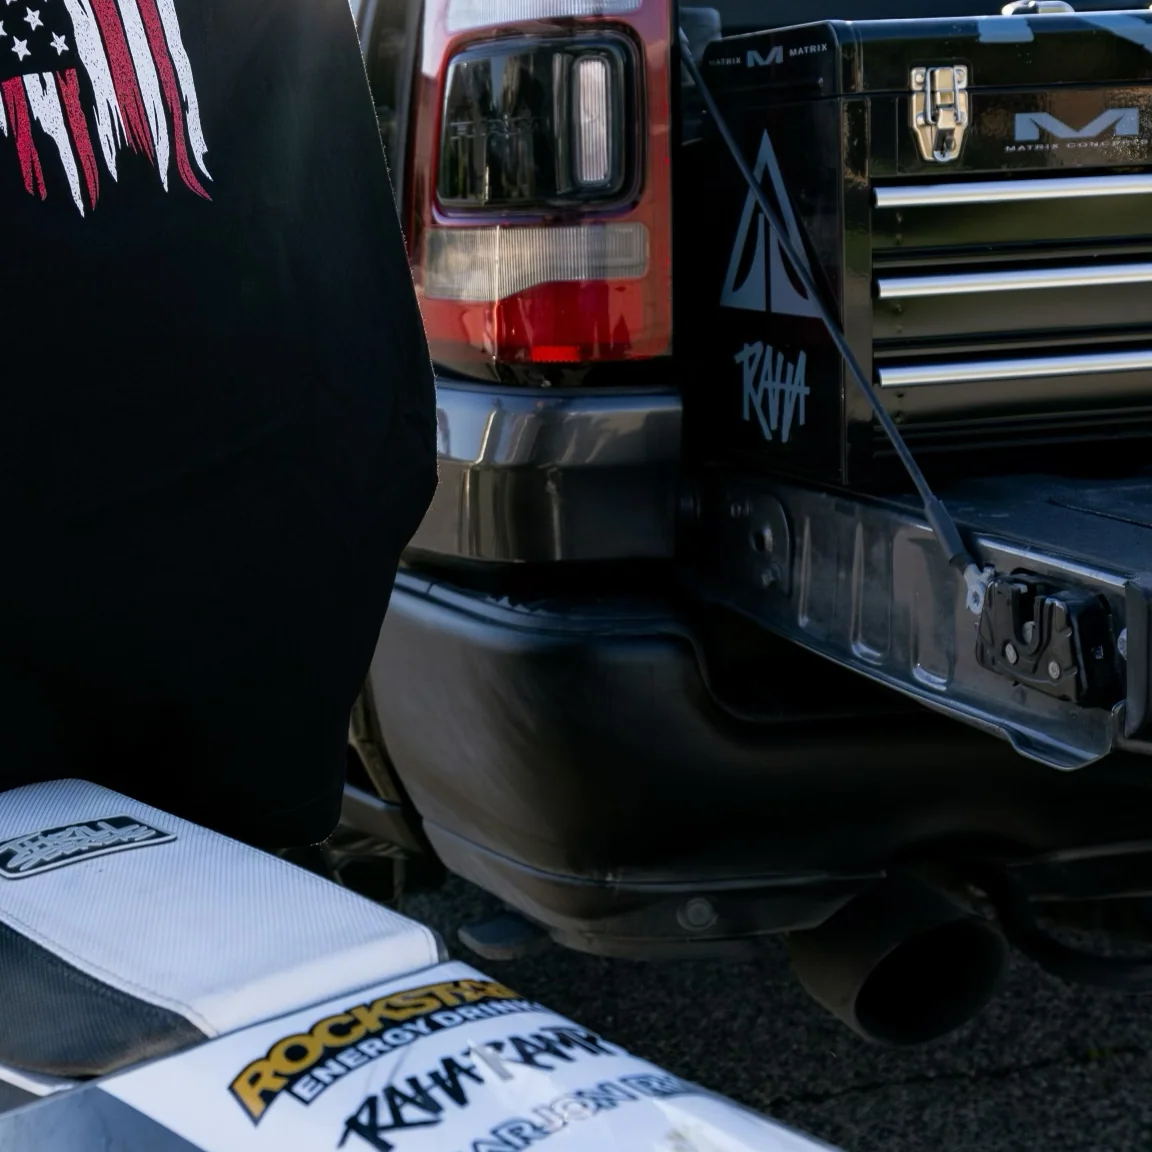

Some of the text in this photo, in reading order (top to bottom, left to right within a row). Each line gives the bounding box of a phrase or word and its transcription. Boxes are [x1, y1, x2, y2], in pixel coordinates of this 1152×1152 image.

[746, 45, 784, 68] M
[788, 43, 829, 57] MATRIX
[1014, 107, 1140, 142] M
[1004, 143, 1060, 153] MATRIX
[734, 341, 811, 443] RAHA
[290, 1017, 428, 1101] ENERGY
